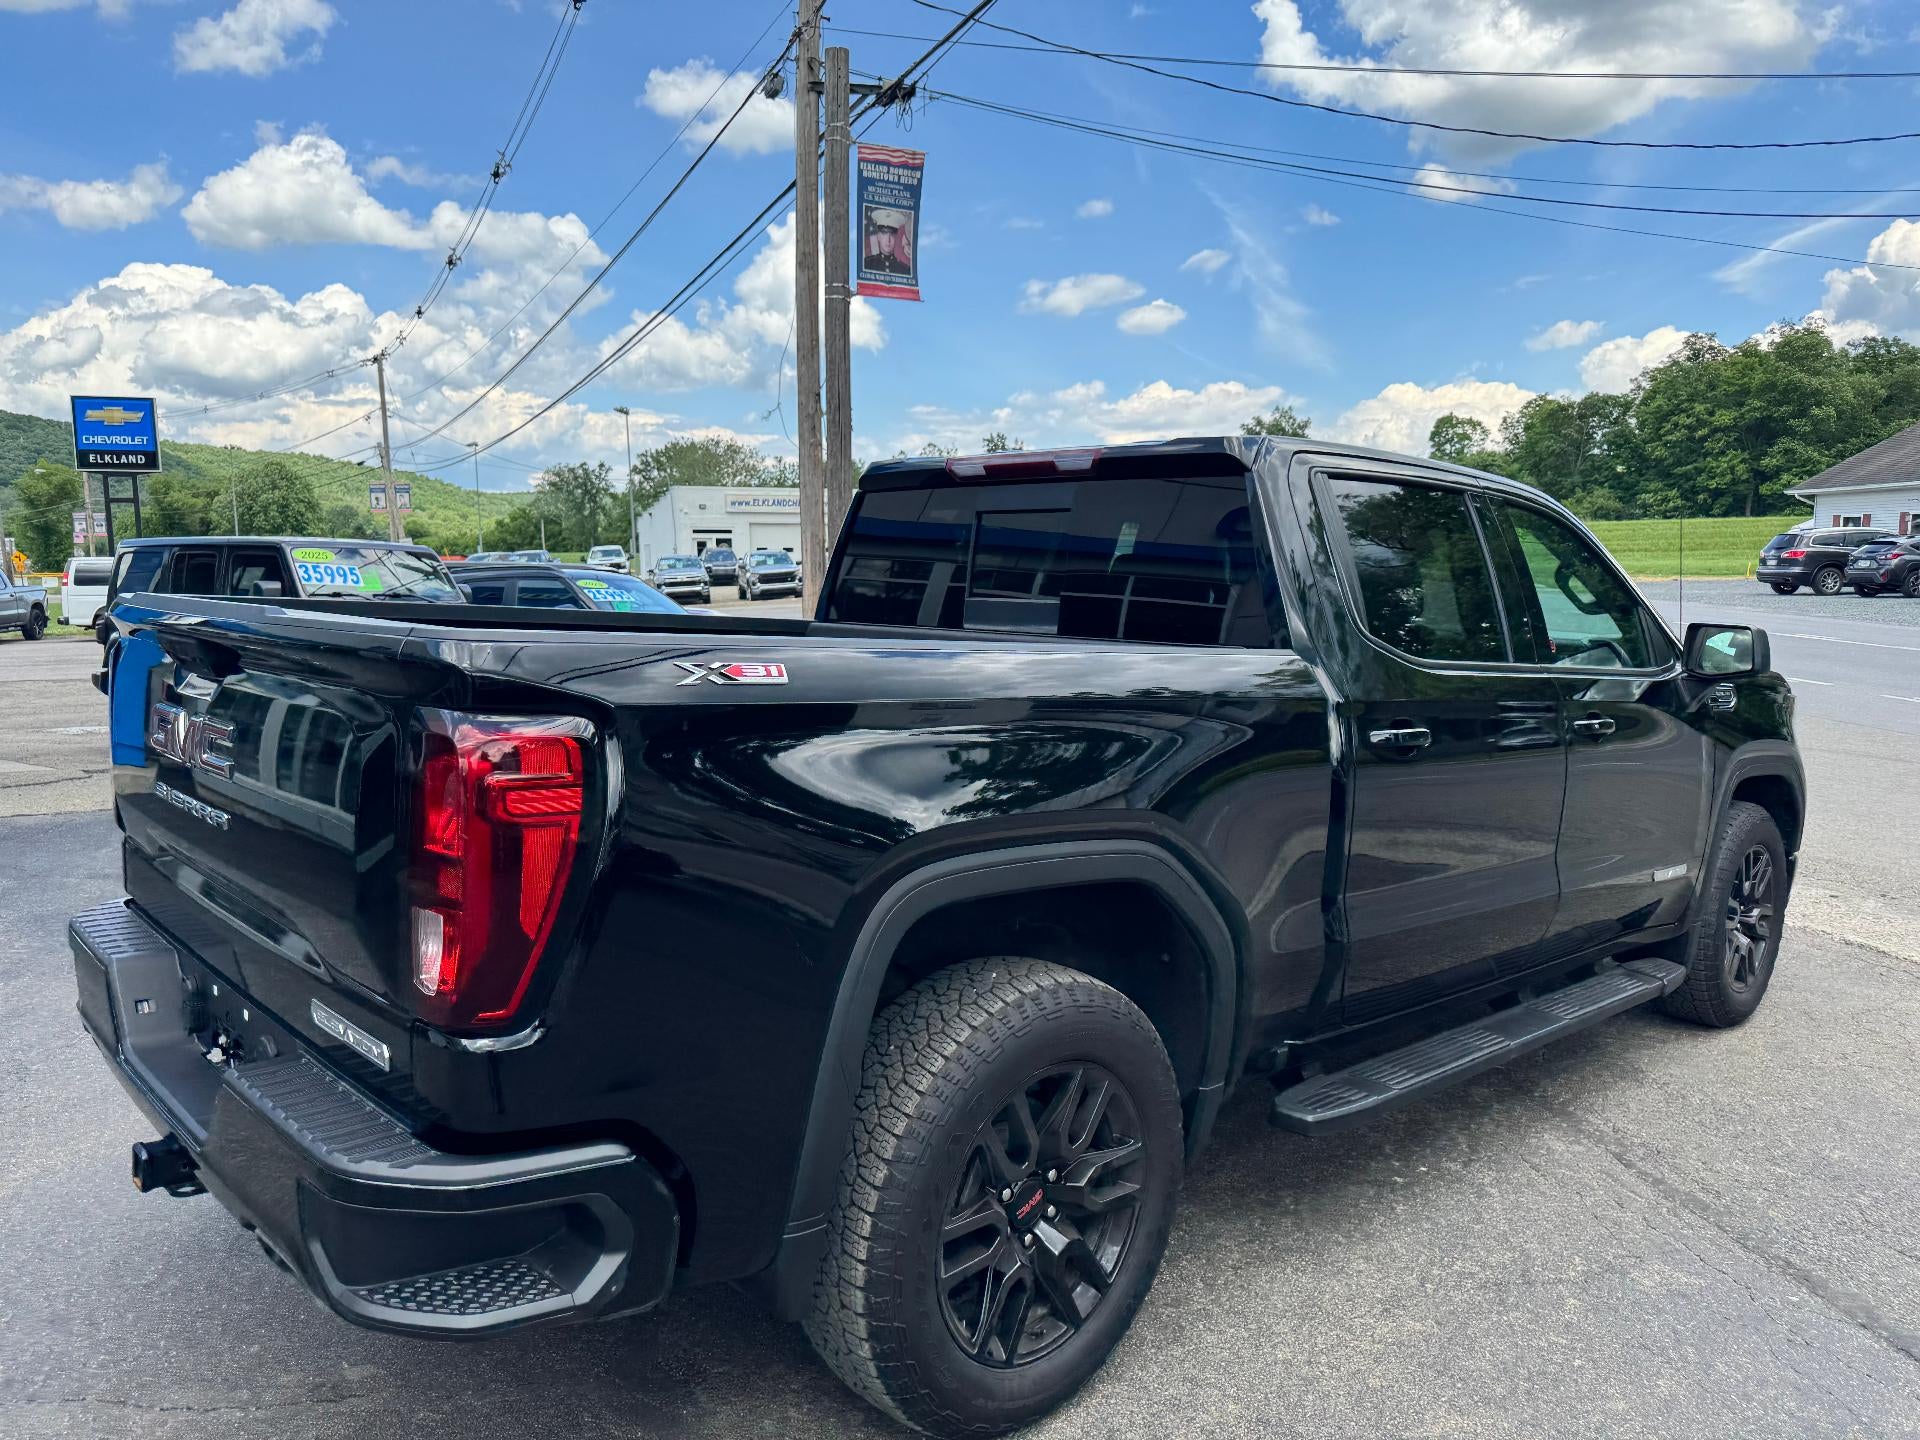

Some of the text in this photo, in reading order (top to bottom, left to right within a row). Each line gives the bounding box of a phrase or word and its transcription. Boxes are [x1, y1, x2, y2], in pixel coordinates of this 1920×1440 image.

[862, 169, 898, 183] HOMETOWN
[900, 176, 918, 185] HERO
[874, 195, 896, 205] MARINE
[896, 198, 914, 207] CORPS
[82, 435, 149, 445] CHEVROLET
[89, 453, 146, 464] ELKLAND
[301, 550, 328, 560] 2025
[297, 564, 361, 585] 35995
[150, 702, 236, 784] GMC
[153, 781, 232, 831] SIERRA
[1016, 1188, 1044, 1220] GMC
